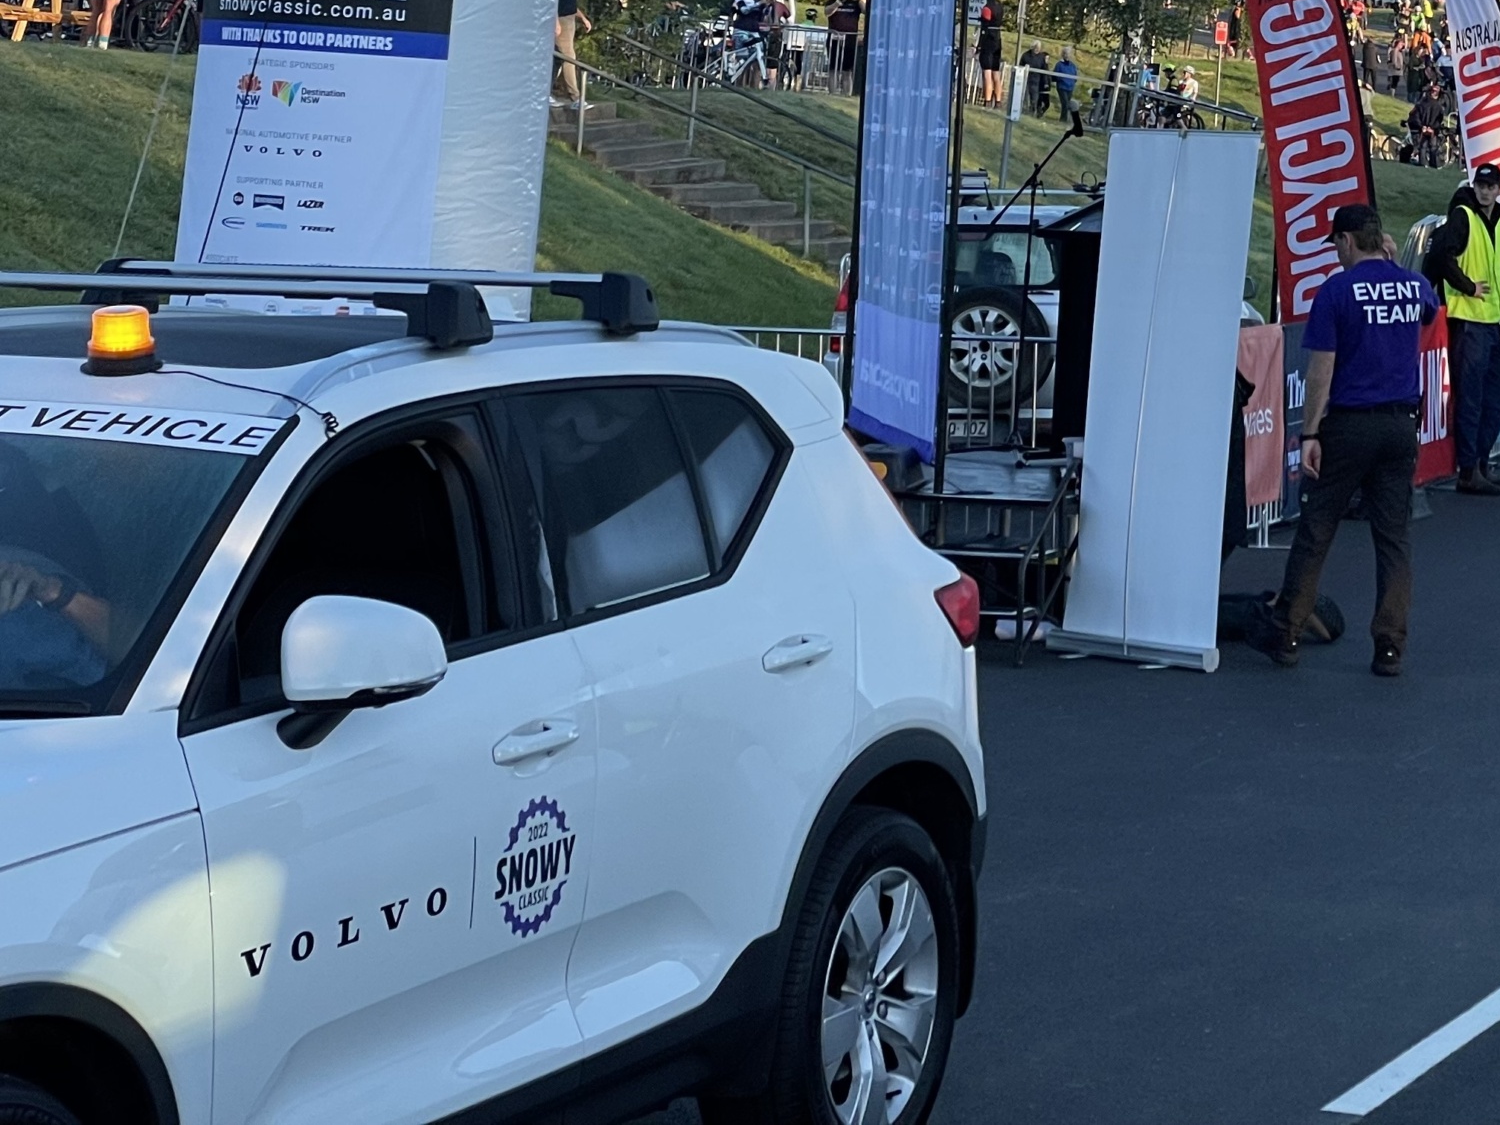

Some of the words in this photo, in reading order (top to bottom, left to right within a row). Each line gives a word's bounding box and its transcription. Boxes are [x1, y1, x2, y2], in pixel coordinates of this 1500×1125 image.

[221, 27, 242, 41] WITH
[243, 28, 281, 43] THANKS
[283, 30, 296, 44] TO
[299, 31, 324, 46] OUR
[326, 33, 393, 51] PARTNERS
[289, 60, 335, 71] SPONSORS
[236, 94, 260, 106] NSW
[301, 88, 346, 97] Destination
[258, 130, 310, 141] AUTOMOTIVE
[312, 133, 352, 144] PARTNER
[243, 145, 322, 158] VOLVO
[236, 176, 283, 186] SUPPORTING
[285, 180, 324, 189] PARTNER
[297, 199, 325, 209] LAZER
[299, 225, 336, 233] TREK
[1352, 281, 1420, 301] EVENT
[1363, 304, 1421, 324] TEAM
[31, 407, 277, 448] VEHICLE
[527, 821, 548, 842] 2022
[494, 834, 576, 900] SNOWY
[518, 885, 550, 910] CLASSIC
[240, 887, 447, 978] VOLVO
